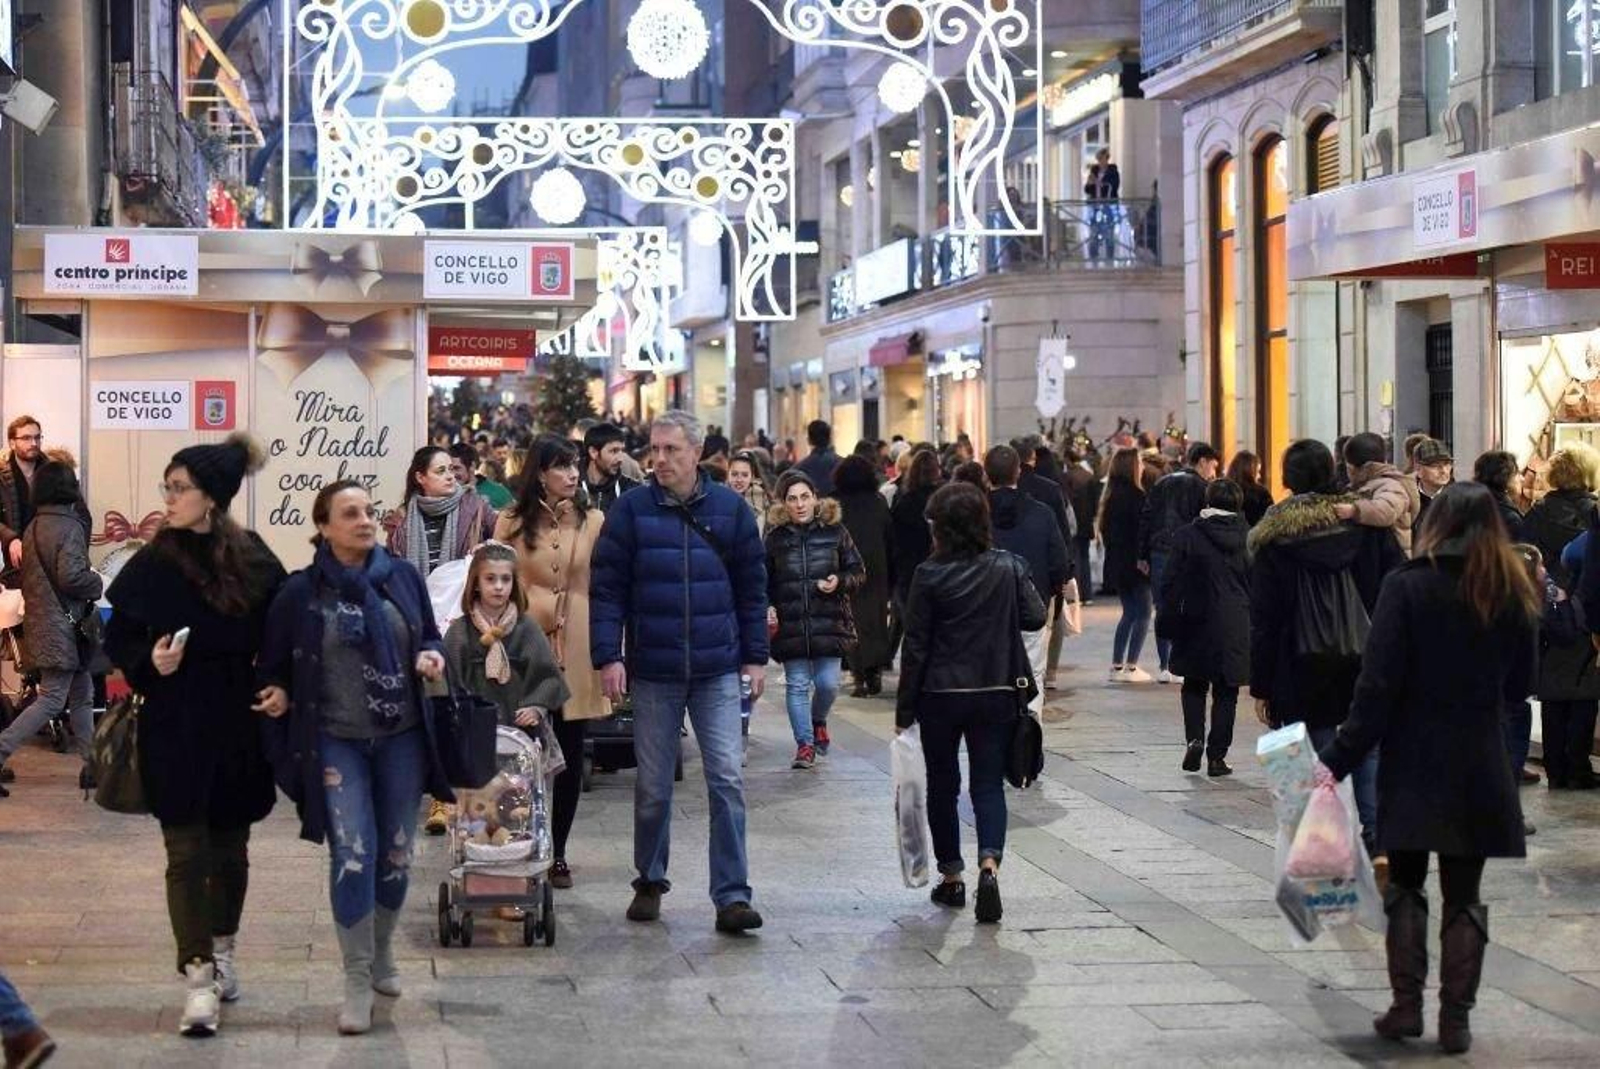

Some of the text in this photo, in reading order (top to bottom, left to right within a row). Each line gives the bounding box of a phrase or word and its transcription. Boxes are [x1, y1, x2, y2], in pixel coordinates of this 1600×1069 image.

[434, 255, 518, 269] CONCELLO
[54, 264, 188, 283] centro príncipe
[444, 272, 508, 285] DE VIGO
[440, 336, 517, 350] ARTCOIRIS
[97, 391, 182, 404] CONCELLO
[107, 407, 172, 419] DE VIGO
[295, 390, 364, 423] Mira
[270, 425, 389, 457] o Nadal
[278, 474, 324, 491] coa
[269, 494, 306, 526] da
